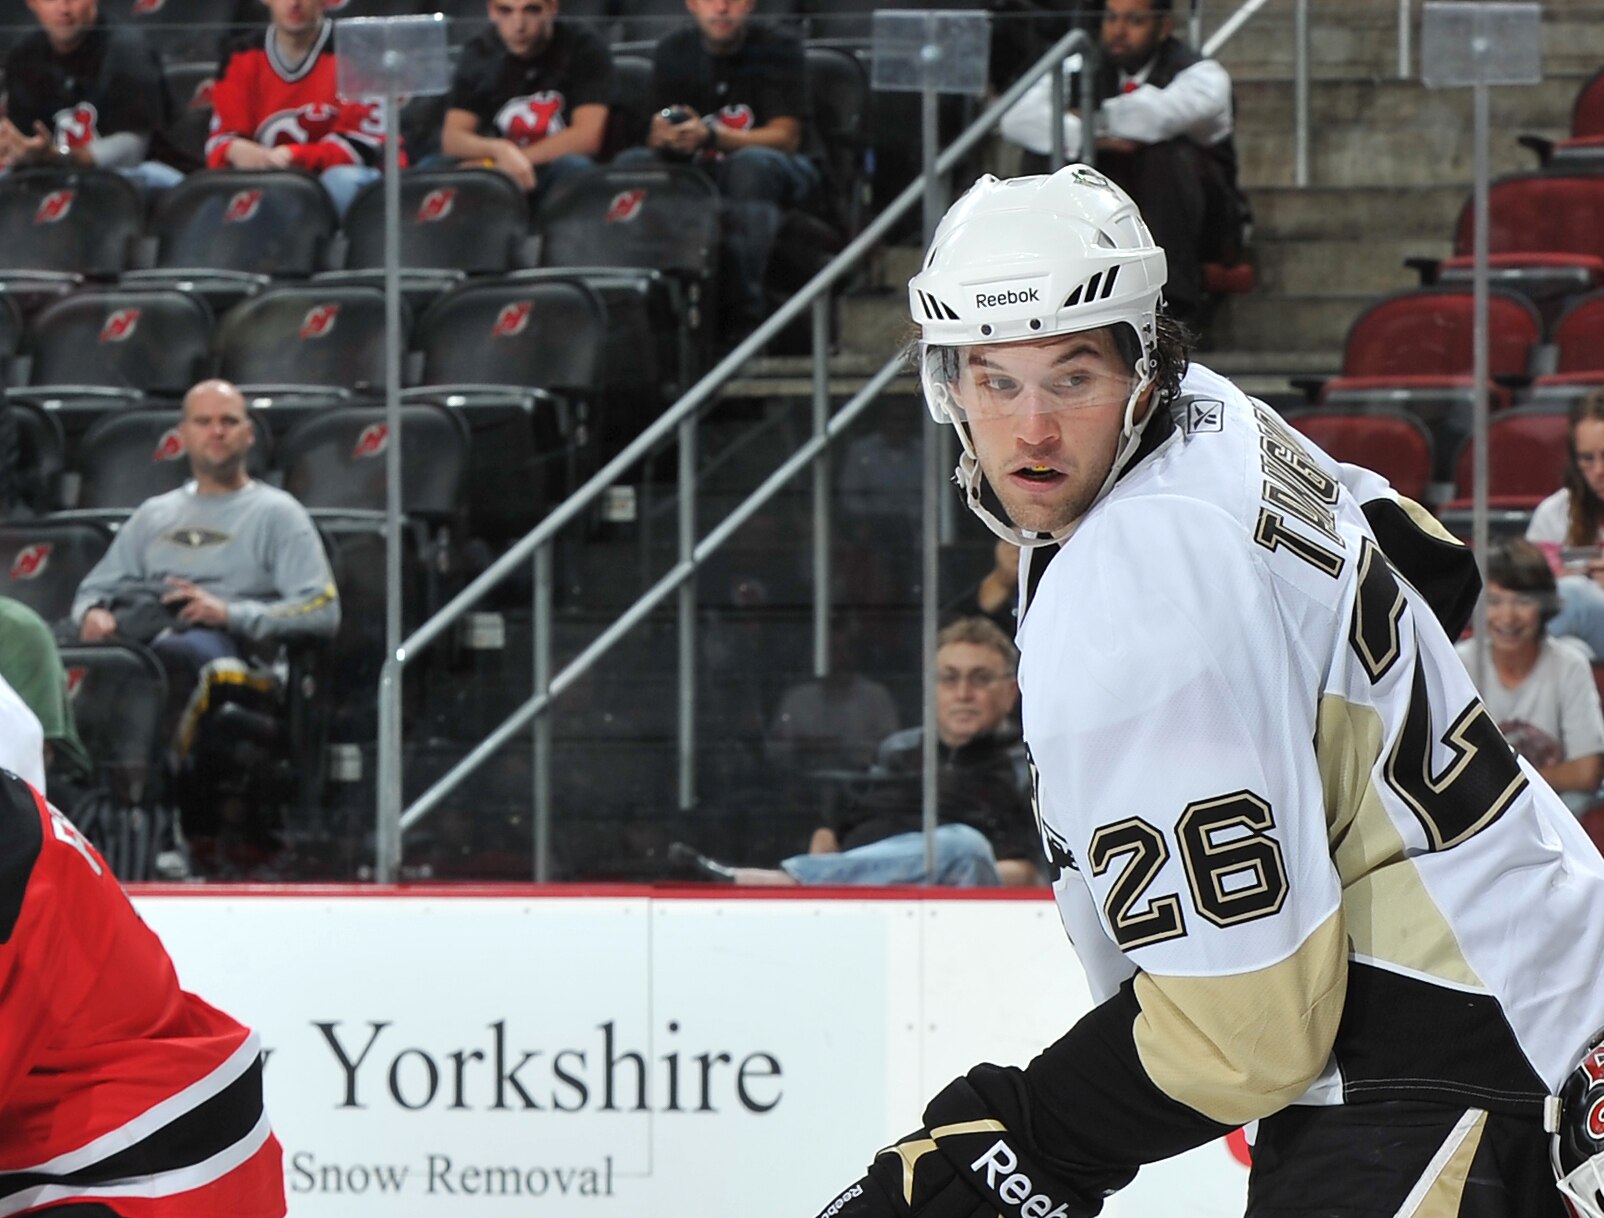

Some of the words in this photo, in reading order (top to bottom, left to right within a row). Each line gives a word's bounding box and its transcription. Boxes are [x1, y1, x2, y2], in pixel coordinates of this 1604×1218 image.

[976, 287, 1040, 309] Reebok
[1088, 788, 1290, 953] 26
[309, 1018, 785, 1116] Yorkshire
[290, 1151, 409, 1196] Snow
[426, 1153, 616, 1198] Removal
